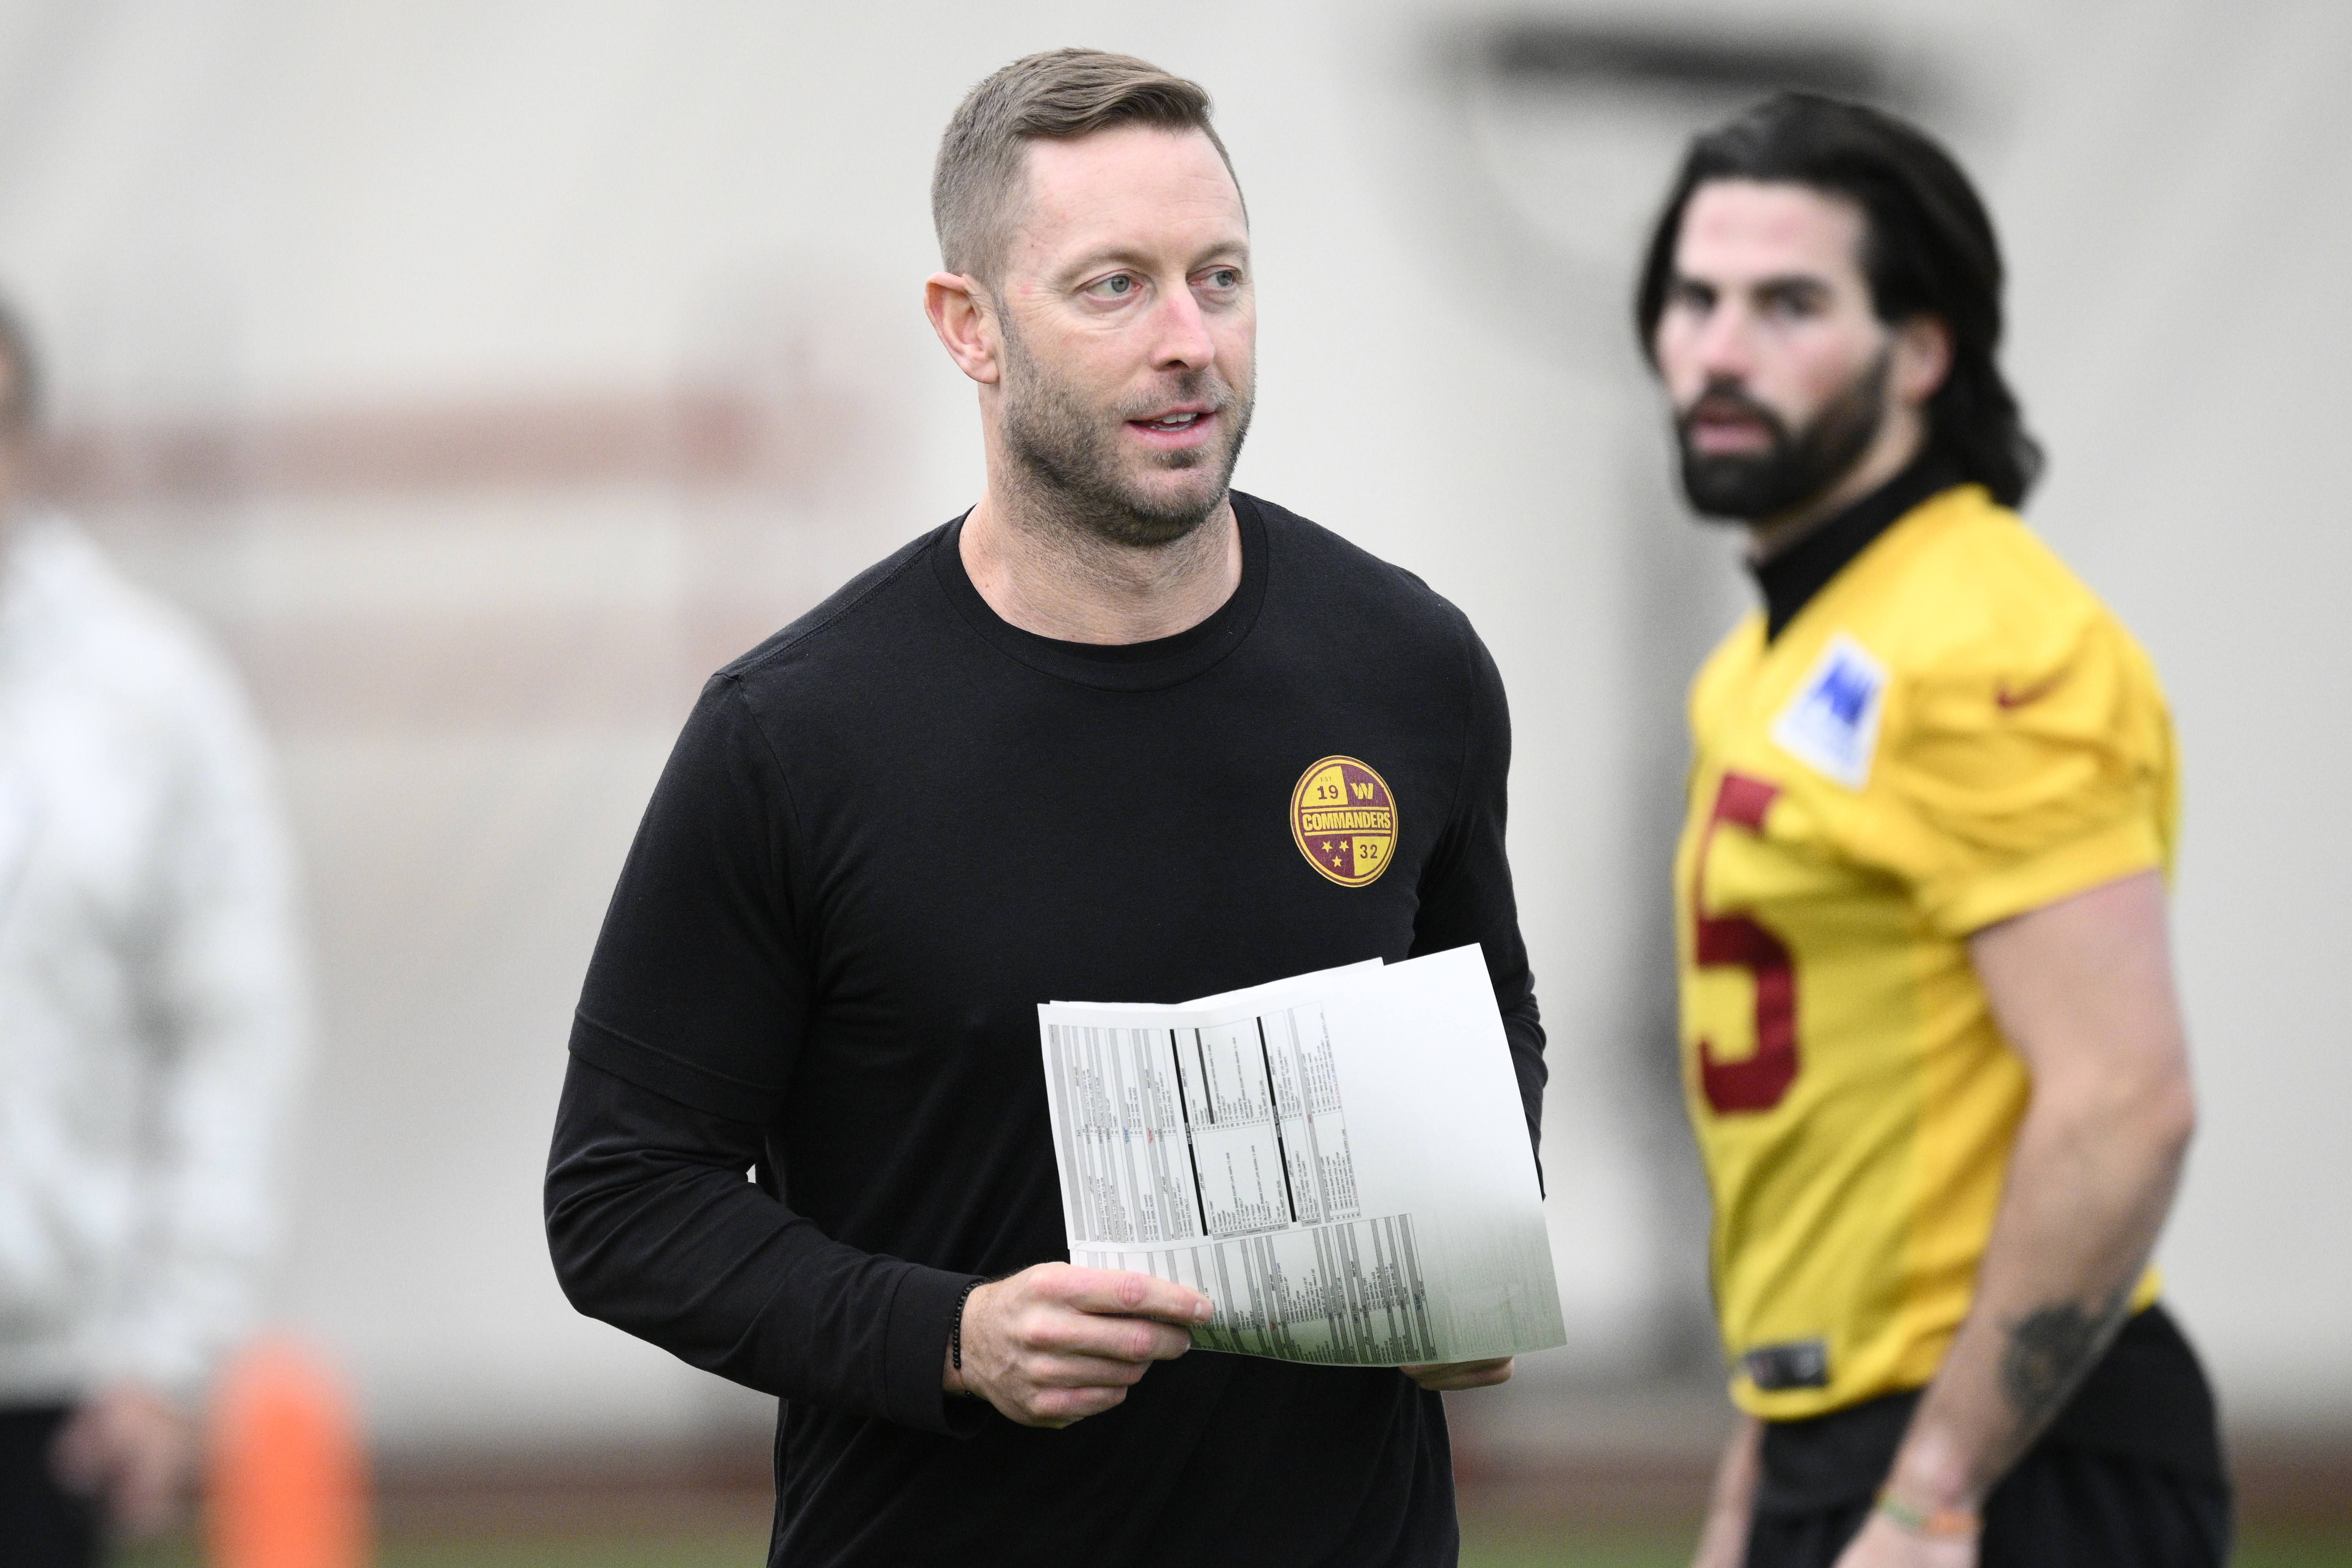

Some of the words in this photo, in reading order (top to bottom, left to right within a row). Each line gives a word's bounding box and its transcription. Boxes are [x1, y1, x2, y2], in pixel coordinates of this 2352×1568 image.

[1317, 784, 1339, 800] 19
[1350, 783, 1374, 800] W
[1302, 811, 1391, 831] COMMANDERS
[1360, 844, 1378, 859] 32
[1692, 772, 1801, 1118] 5
